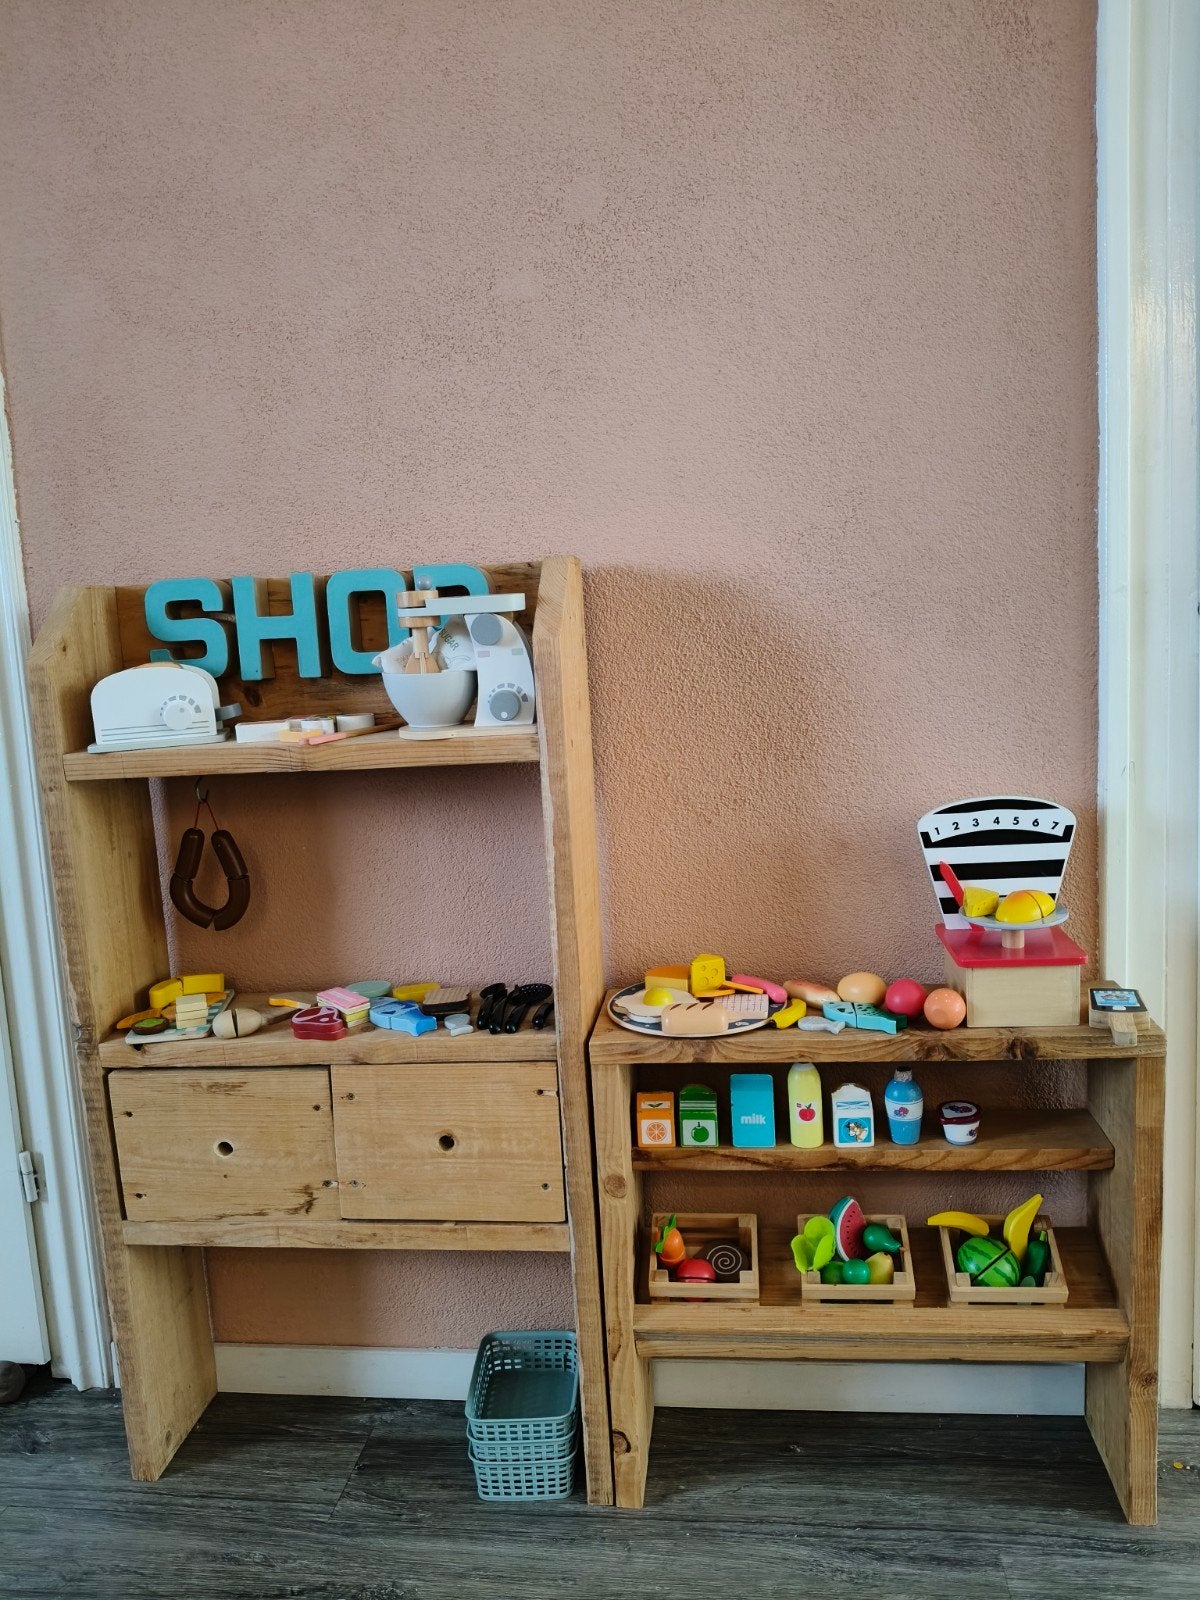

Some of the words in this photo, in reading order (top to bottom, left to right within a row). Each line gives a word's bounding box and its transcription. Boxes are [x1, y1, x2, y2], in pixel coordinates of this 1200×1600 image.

[439, 628, 459, 651] SUGAR
[934, 826, 940, 835] 1
[952, 821, 960, 831] 2
[972, 818, 980, 827] 3
[993, 816, 1001, 825] 4
[1012, 816, 1020, 825] 5
[1032, 818, 1040, 827] 6
[1051, 821, 1059, 830] 7
[741, 1113, 766, 1125] milk
